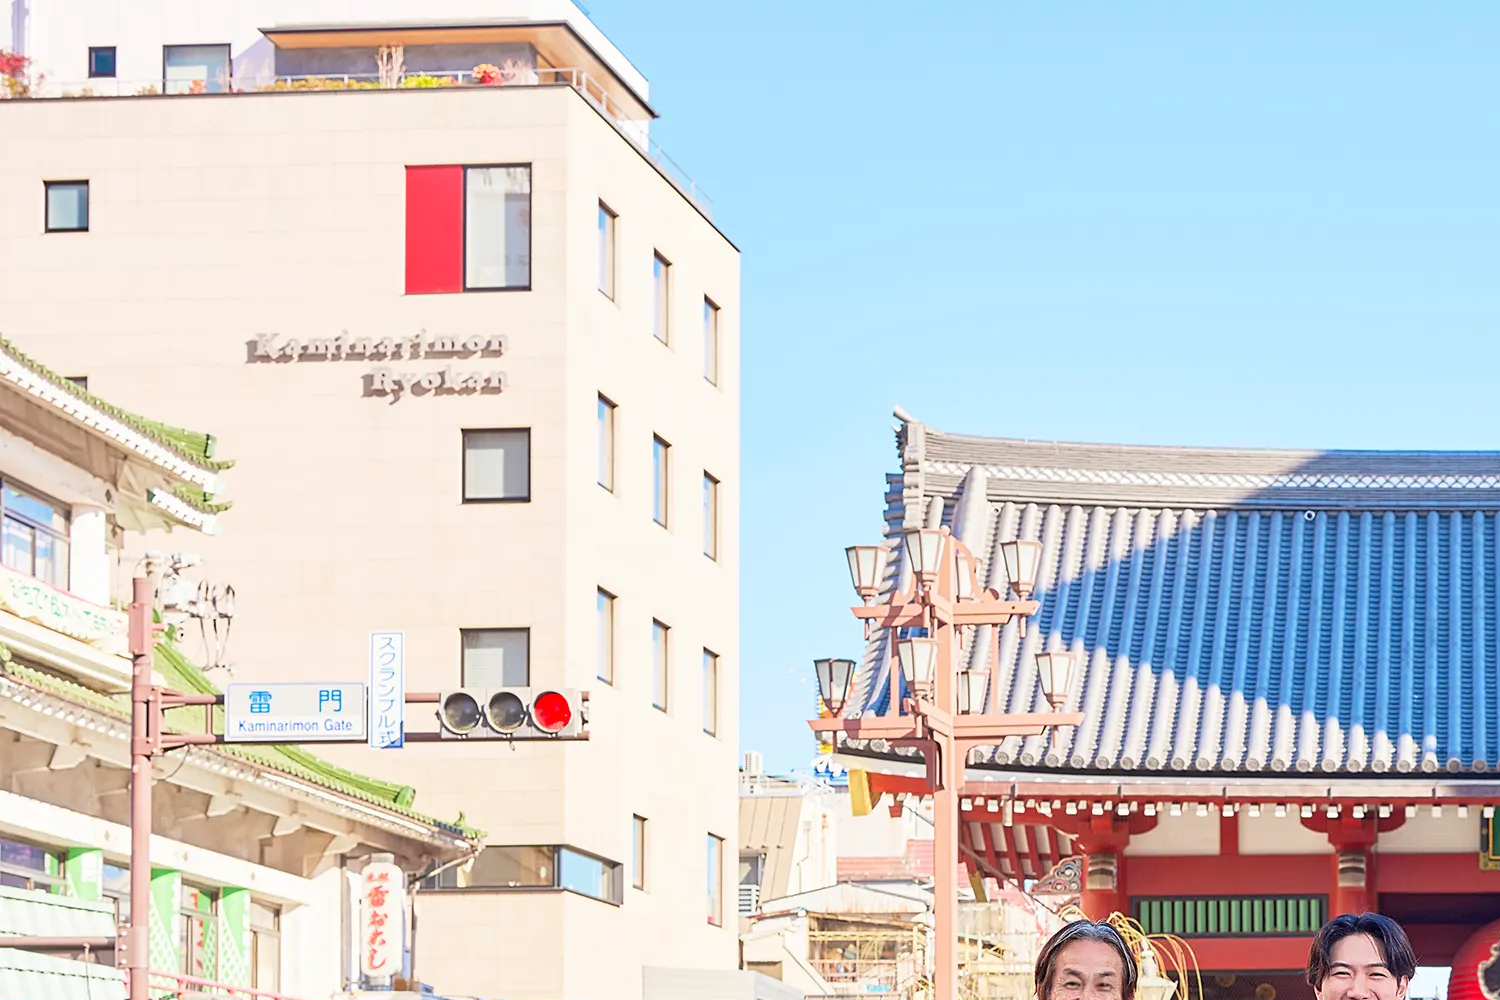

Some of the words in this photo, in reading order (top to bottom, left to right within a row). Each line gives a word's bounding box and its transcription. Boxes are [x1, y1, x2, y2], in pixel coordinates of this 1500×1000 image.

[250, 329, 508, 361] Kaminarimon
[365, 366, 508, 400] Ryokan
[249, 689, 343, 713] 雷門
[239, 720, 319, 733] Kaminarimon
[324, 718, 353, 732] Gate
